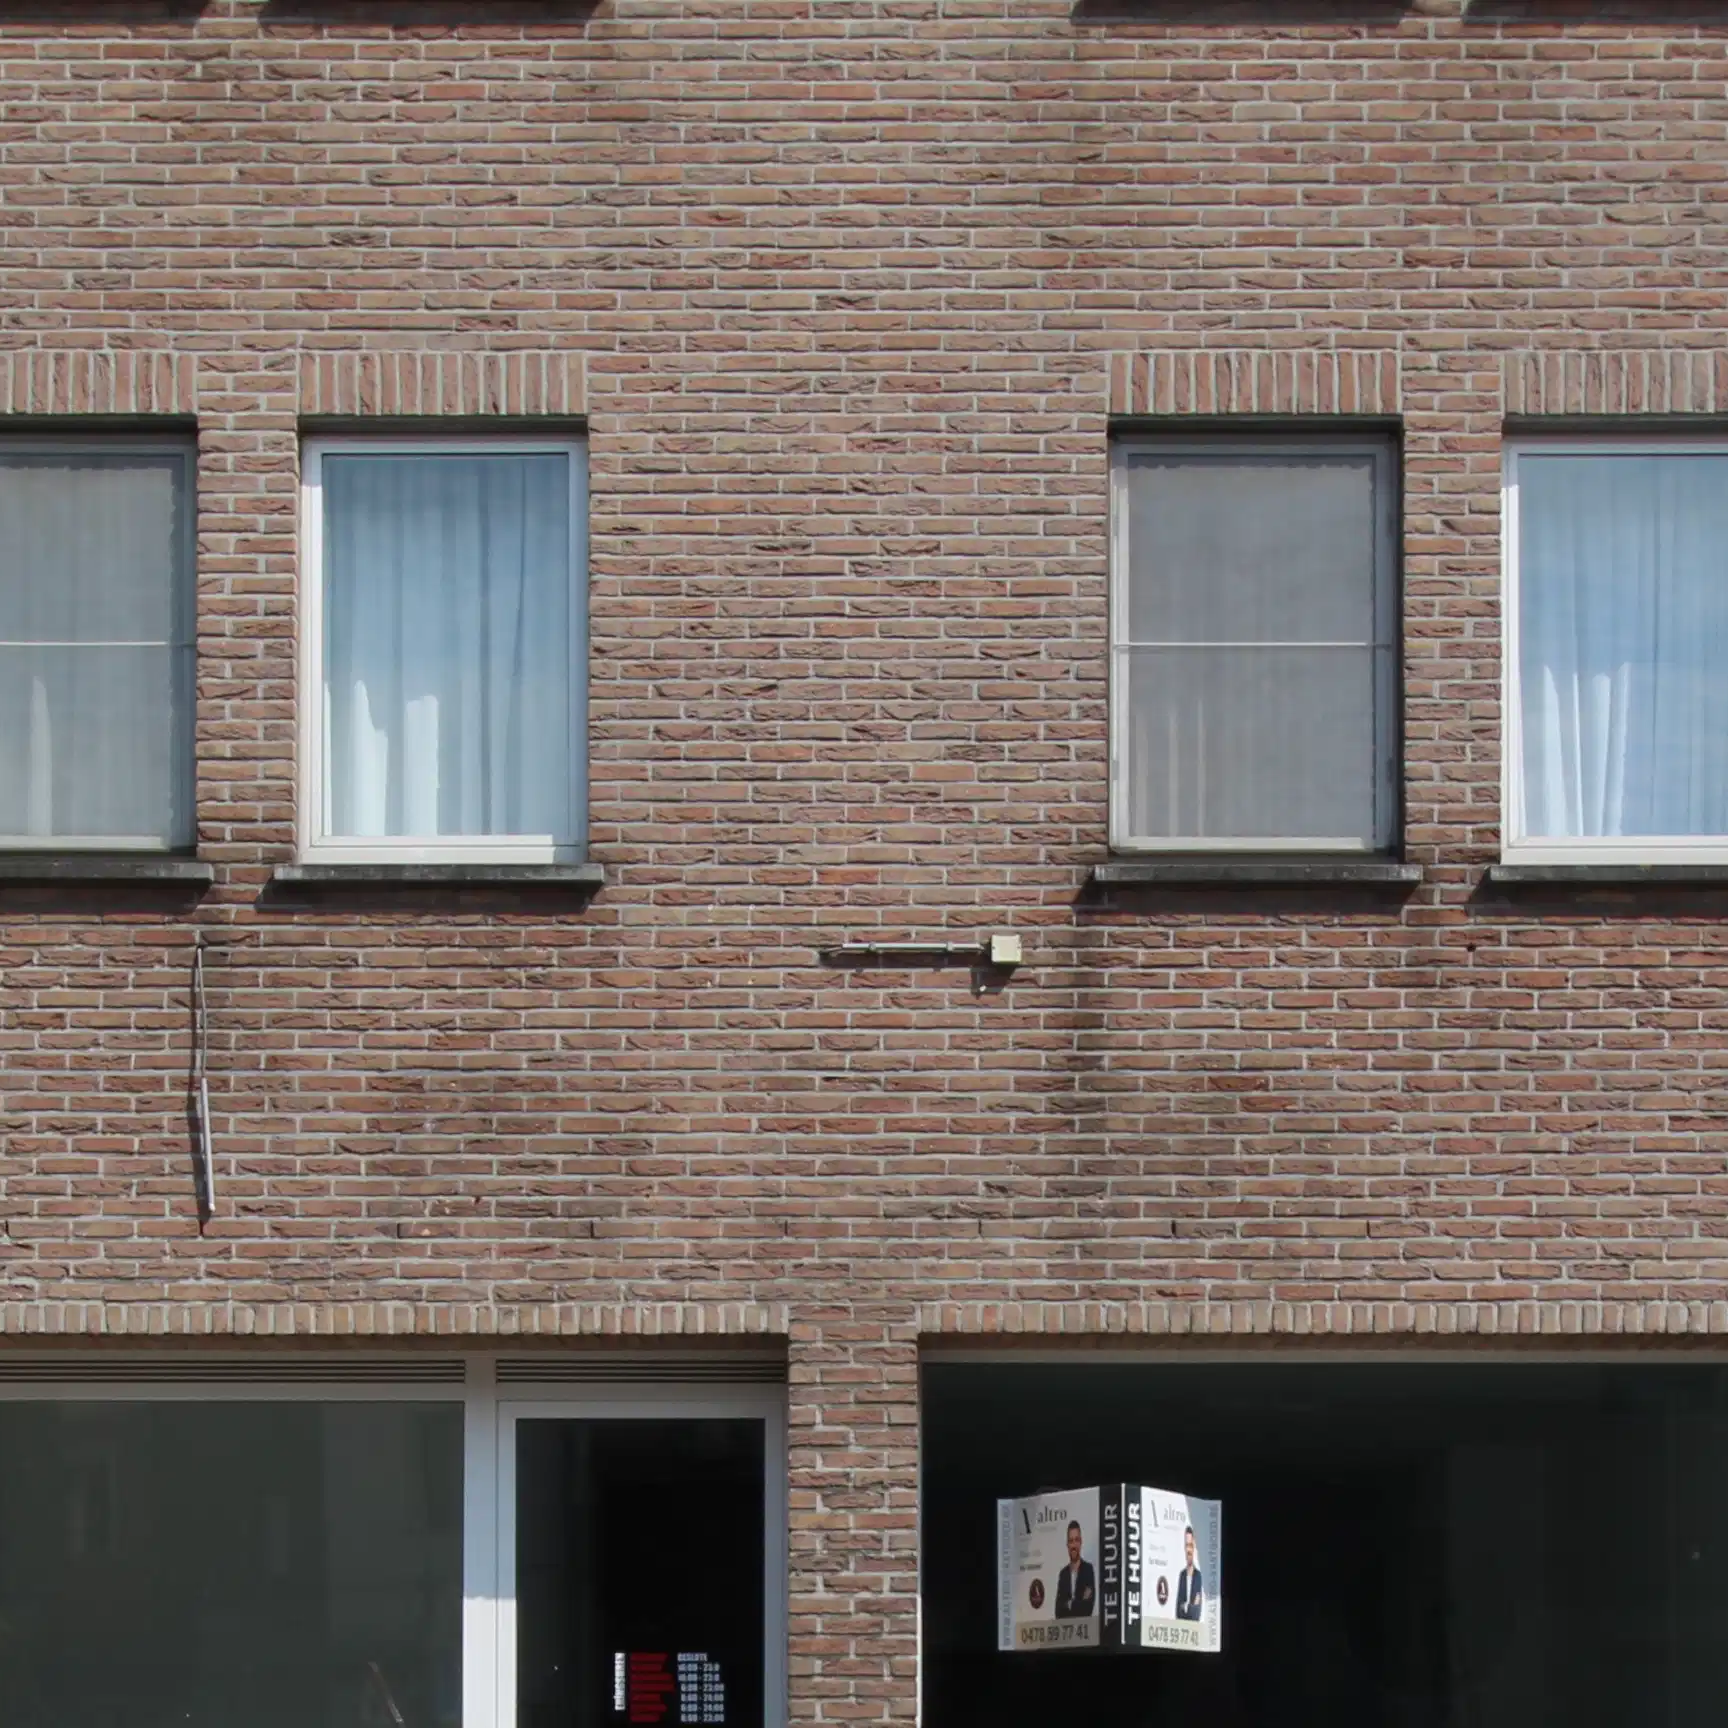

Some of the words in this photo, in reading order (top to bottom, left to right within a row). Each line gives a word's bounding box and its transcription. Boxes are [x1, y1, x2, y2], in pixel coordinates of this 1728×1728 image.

[1038, 1505, 1068, 1524] altro
[1163, 1502, 1186, 1523] altro
[1104, 1503, 1118, 1583] HUUR
[1128, 1502, 1141, 1583] HUUR
[1104, 1591, 1118, 1626] TE
[1128, 1591, 1141, 1626] TE
[1062, 1624, 1075, 1641] 77
[1076, 1623, 1089, 1640] 41
